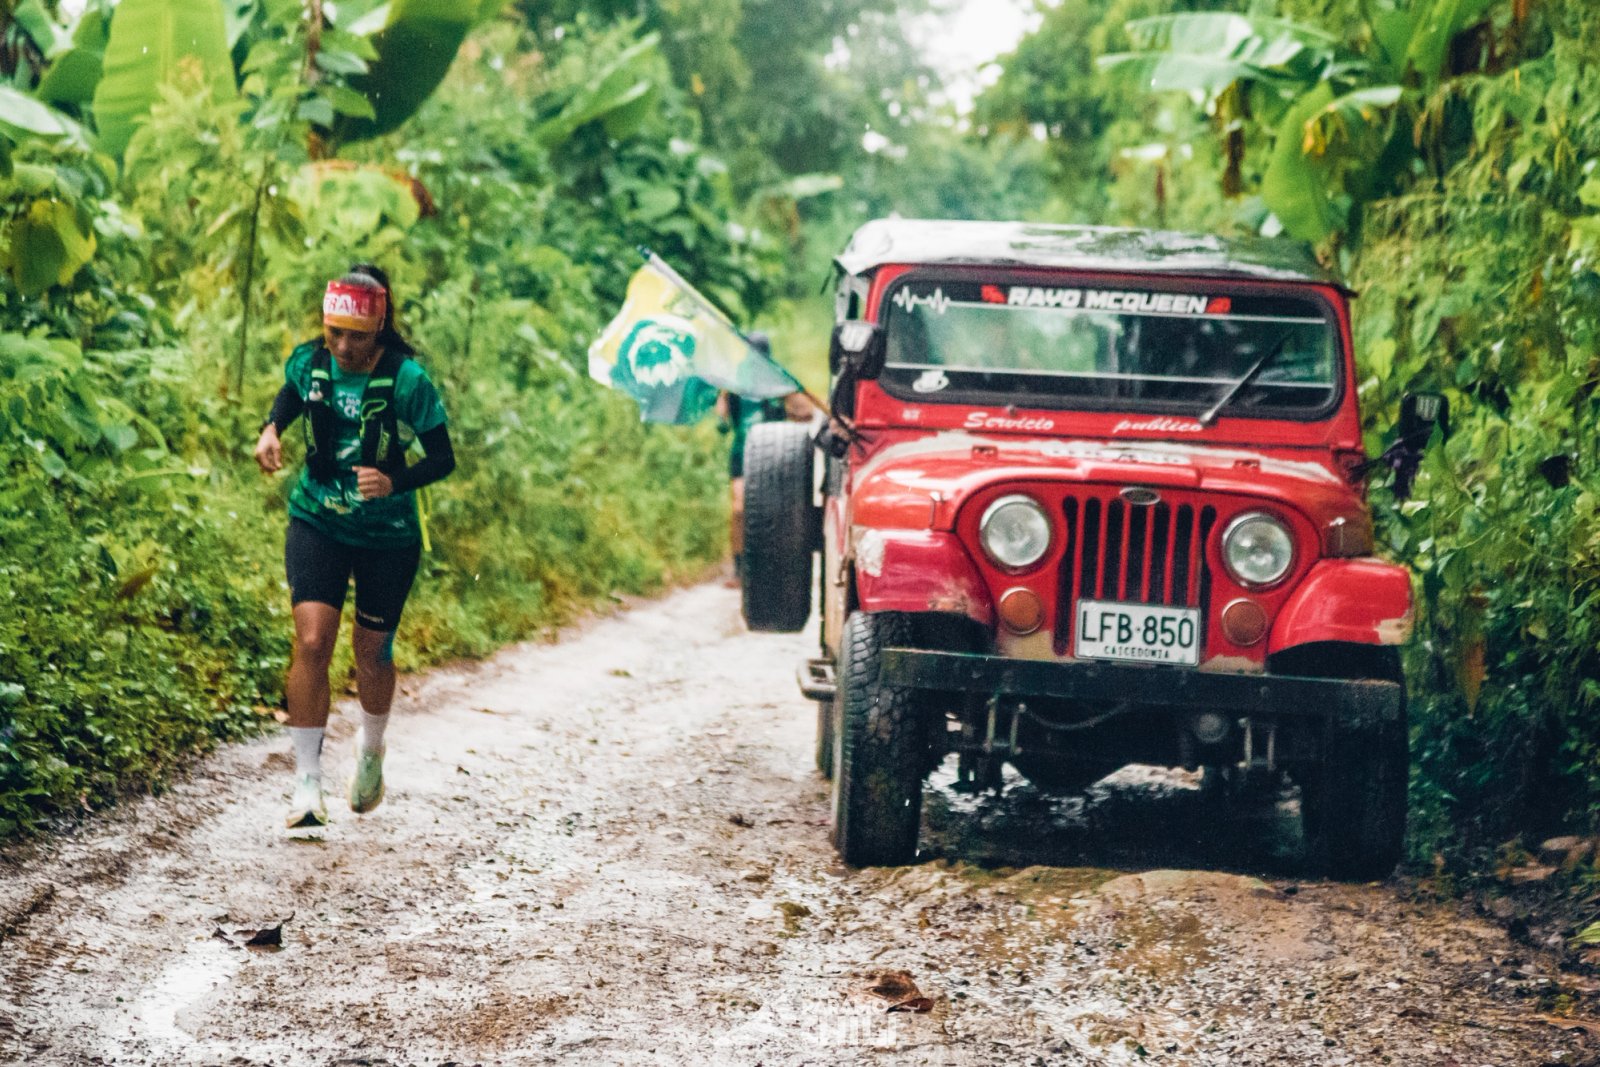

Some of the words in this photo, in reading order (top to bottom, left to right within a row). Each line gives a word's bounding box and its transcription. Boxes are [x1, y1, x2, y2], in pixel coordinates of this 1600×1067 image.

[1008, 286, 1081, 306] RAYO
[1085, 290, 1208, 314] MCQUEEN
[963, 411, 1055, 430] Servicio
[1112, 417, 1203, 433] publico
